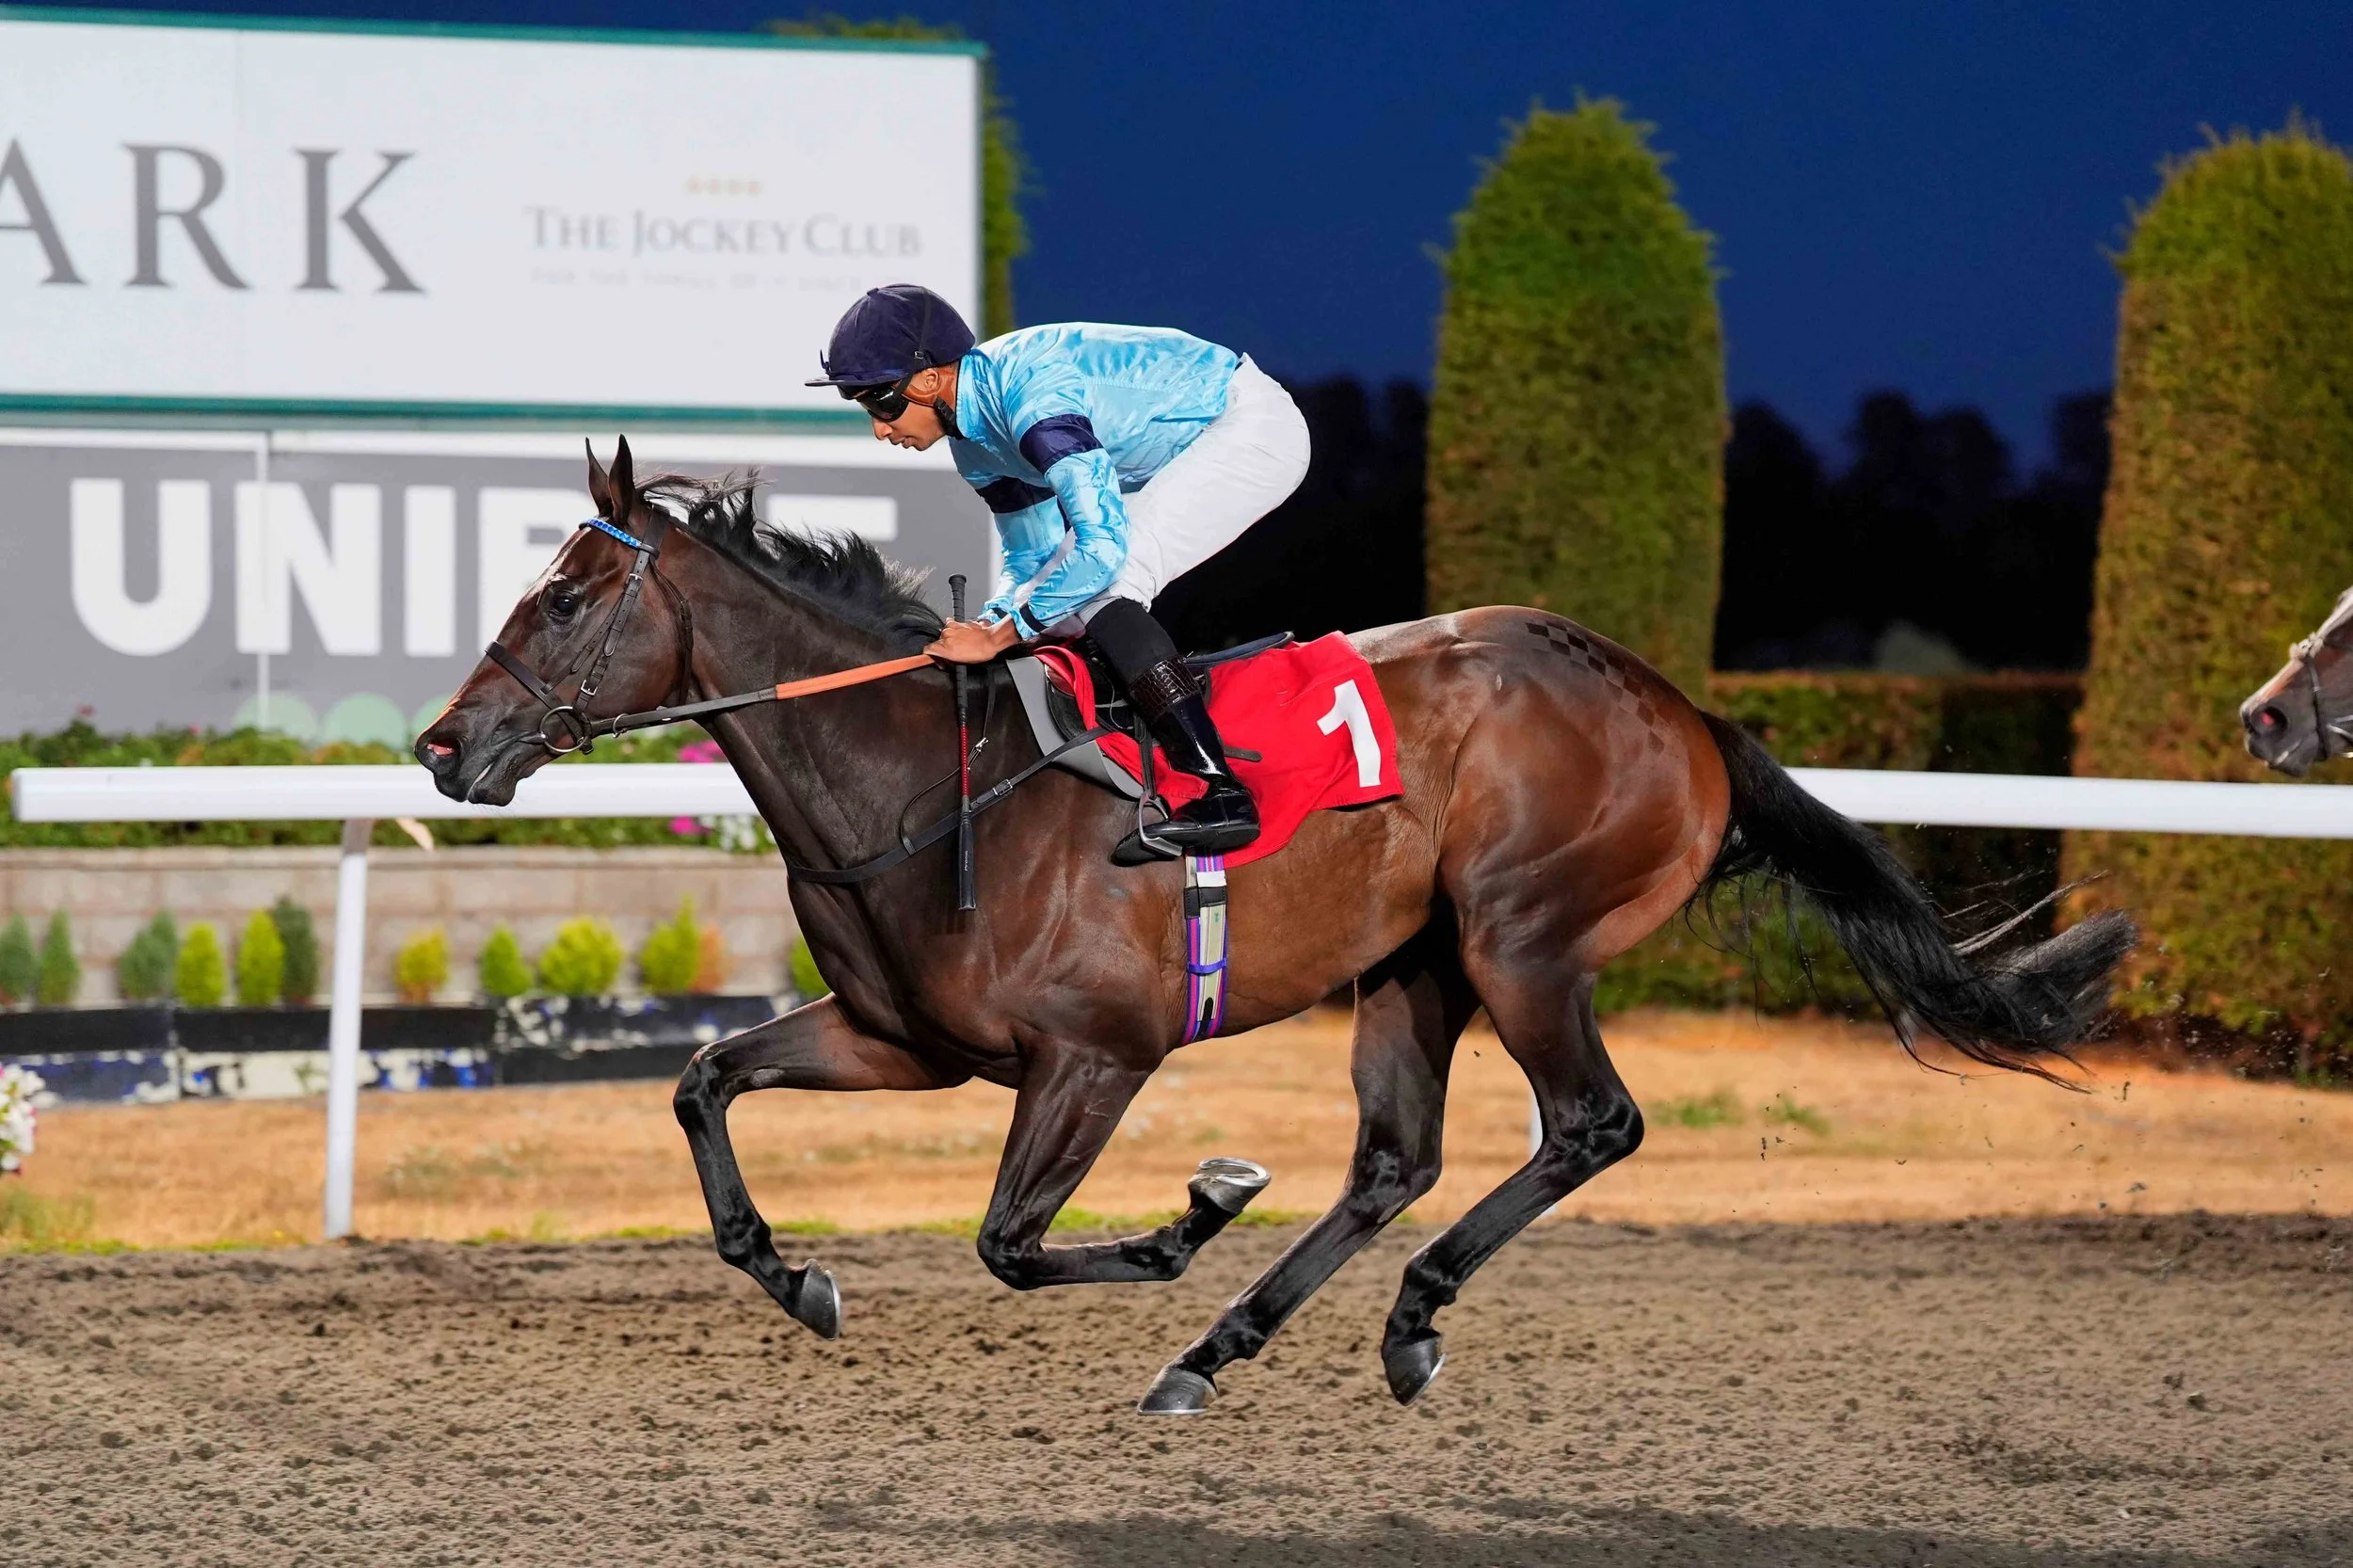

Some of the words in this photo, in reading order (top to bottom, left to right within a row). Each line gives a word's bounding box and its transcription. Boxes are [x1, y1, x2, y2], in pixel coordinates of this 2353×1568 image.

[0, 137, 426, 294] ARK
[632, 207, 795, 258] JOCKEY
[803, 211, 924, 257] CLUB
[1316, 679, 1382, 788] 1
